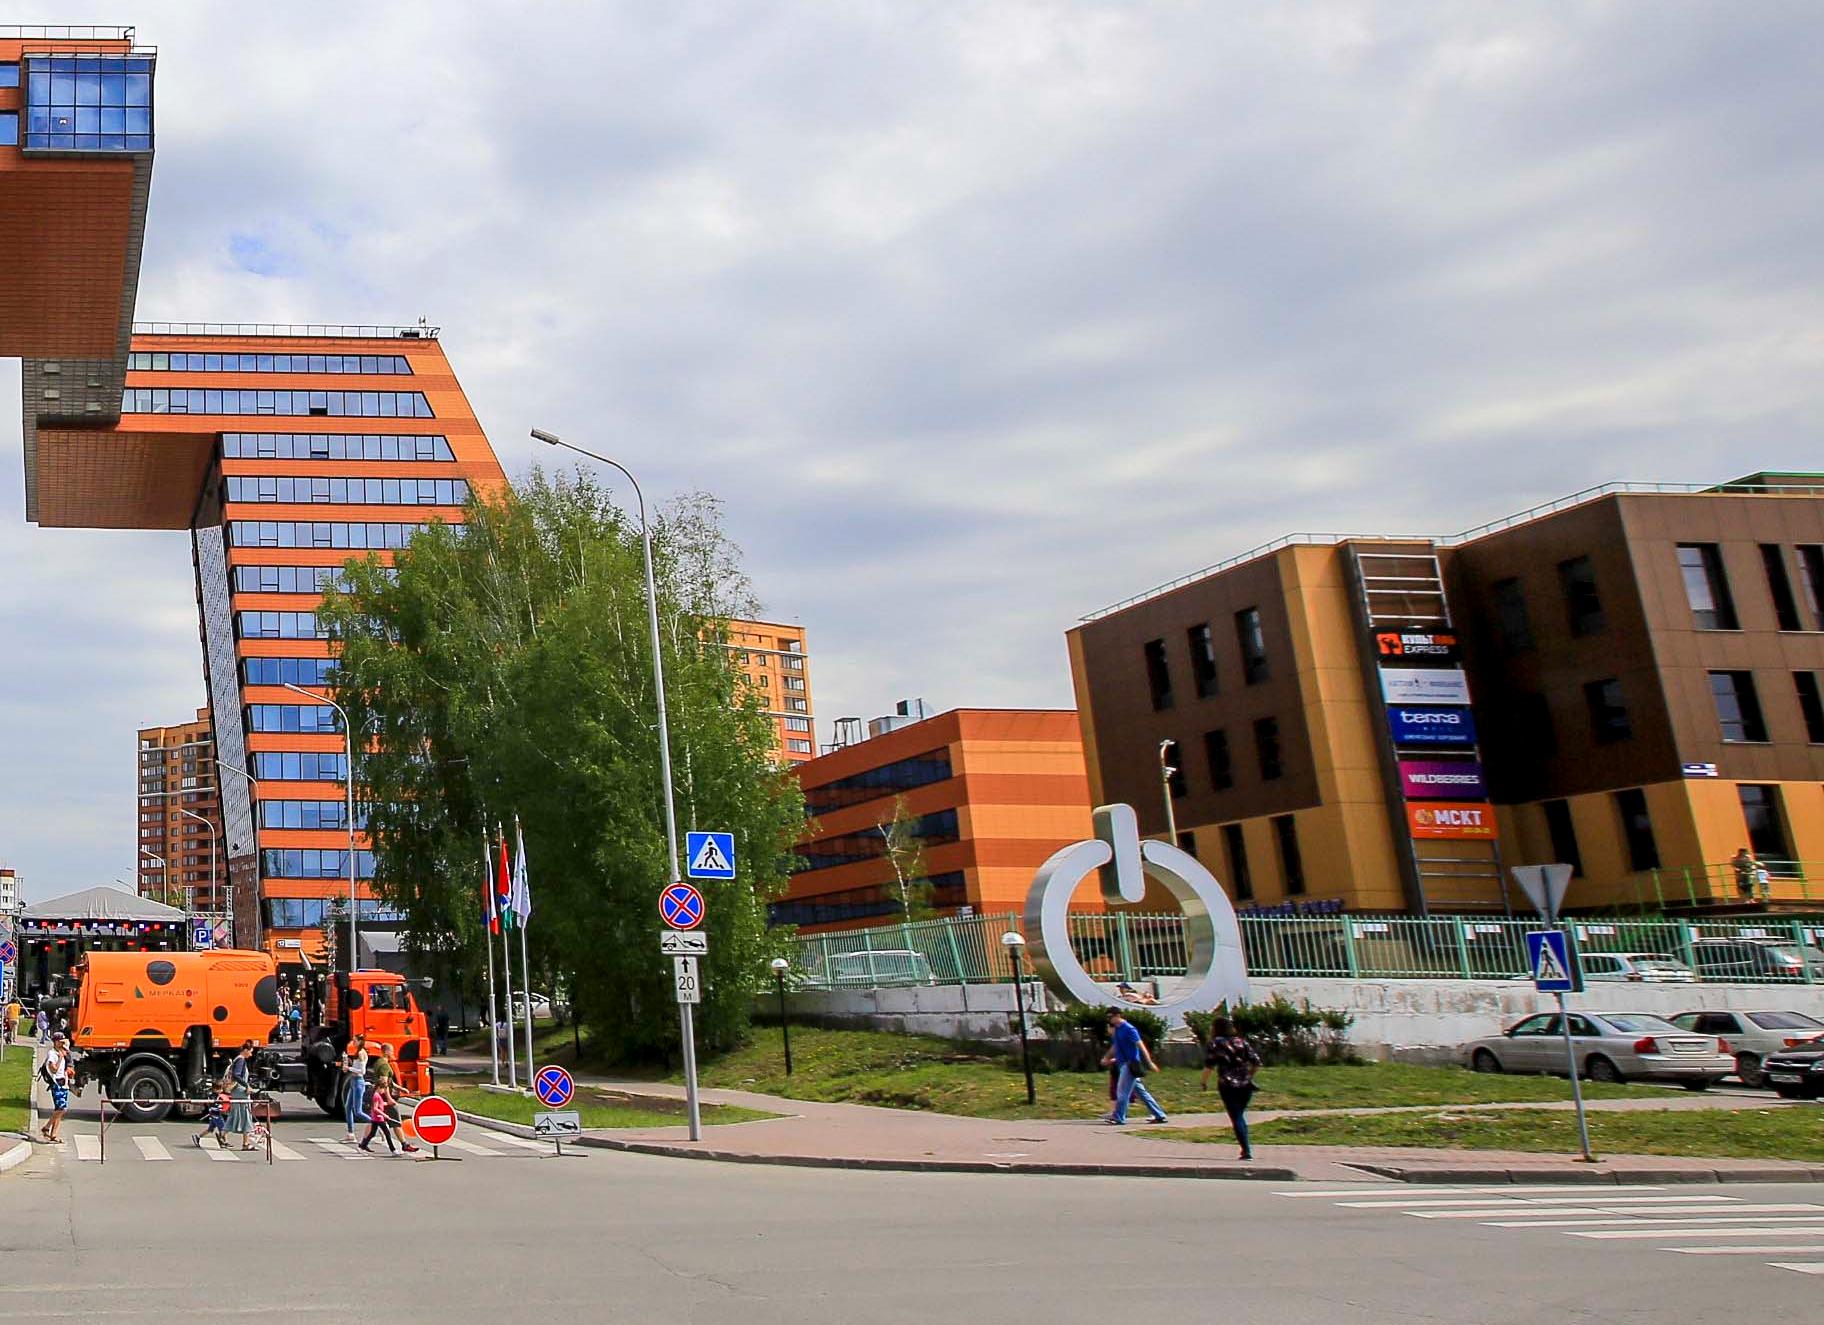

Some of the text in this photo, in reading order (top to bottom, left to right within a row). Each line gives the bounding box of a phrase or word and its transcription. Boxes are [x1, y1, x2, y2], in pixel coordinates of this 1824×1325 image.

[1404, 645, 1448, 654] EXPRESS
[1408, 774, 1480, 784] WILDBERRIES
[1433, 809, 1482, 826] МСКТ
[678, 976, 695, 990] 20
